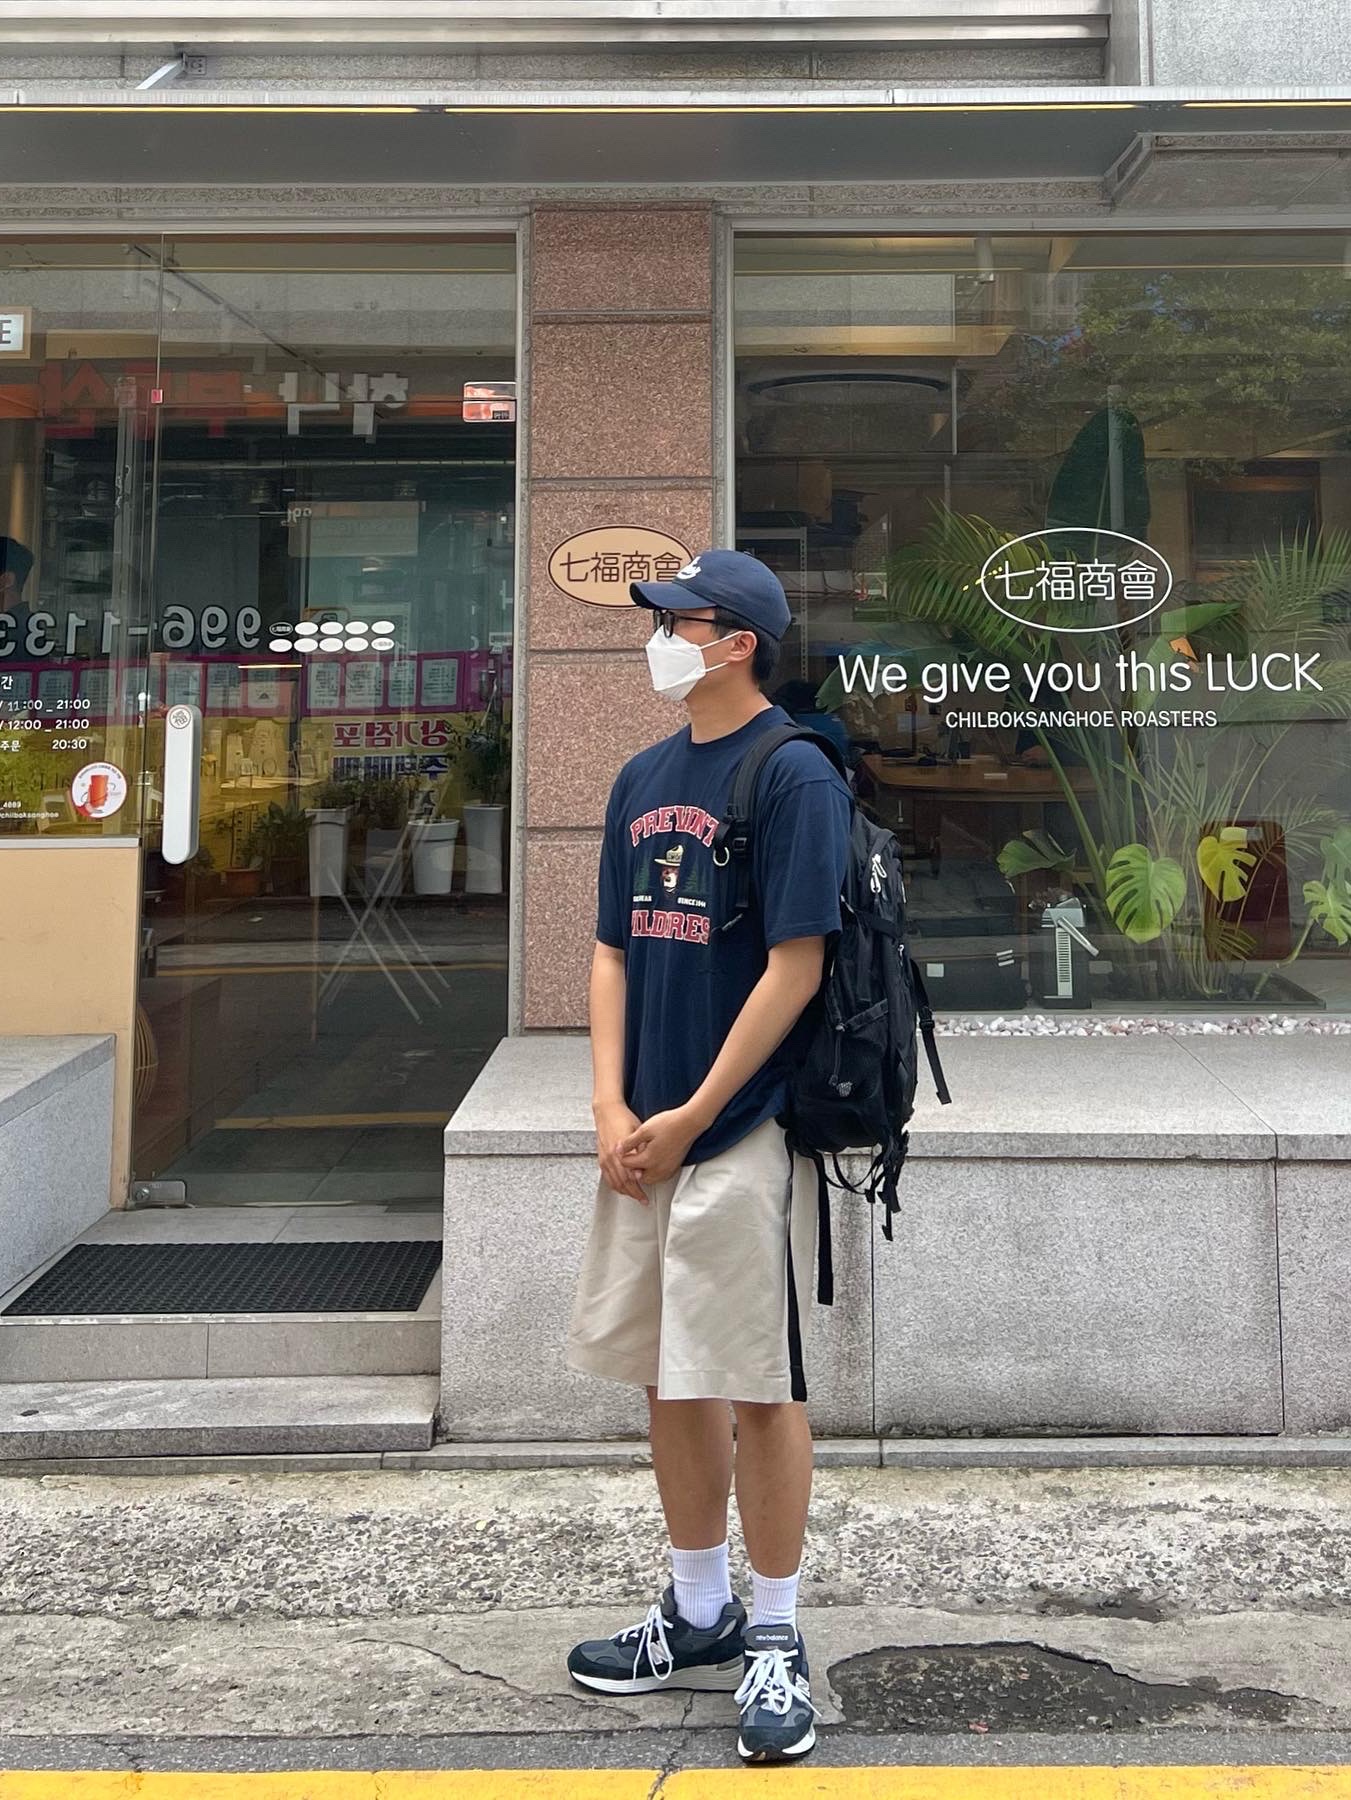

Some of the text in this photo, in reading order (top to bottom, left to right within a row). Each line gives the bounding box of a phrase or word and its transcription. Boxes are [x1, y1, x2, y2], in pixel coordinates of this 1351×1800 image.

[559, 550, 683, 583] 七福商會
[994, 558, 1158, 601] 七福商會
[838, 650, 1324, 704] We give you this LUCK
[56, 698, 91, 710] 21:00
[7, 719, 42, 730] 12:00
[55, 718, 90, 730] 21:00
[945, 710, 1217, 728] CHILBOKSANGHOE ROASTERS
[52, 739, 87, 750] 20:30
